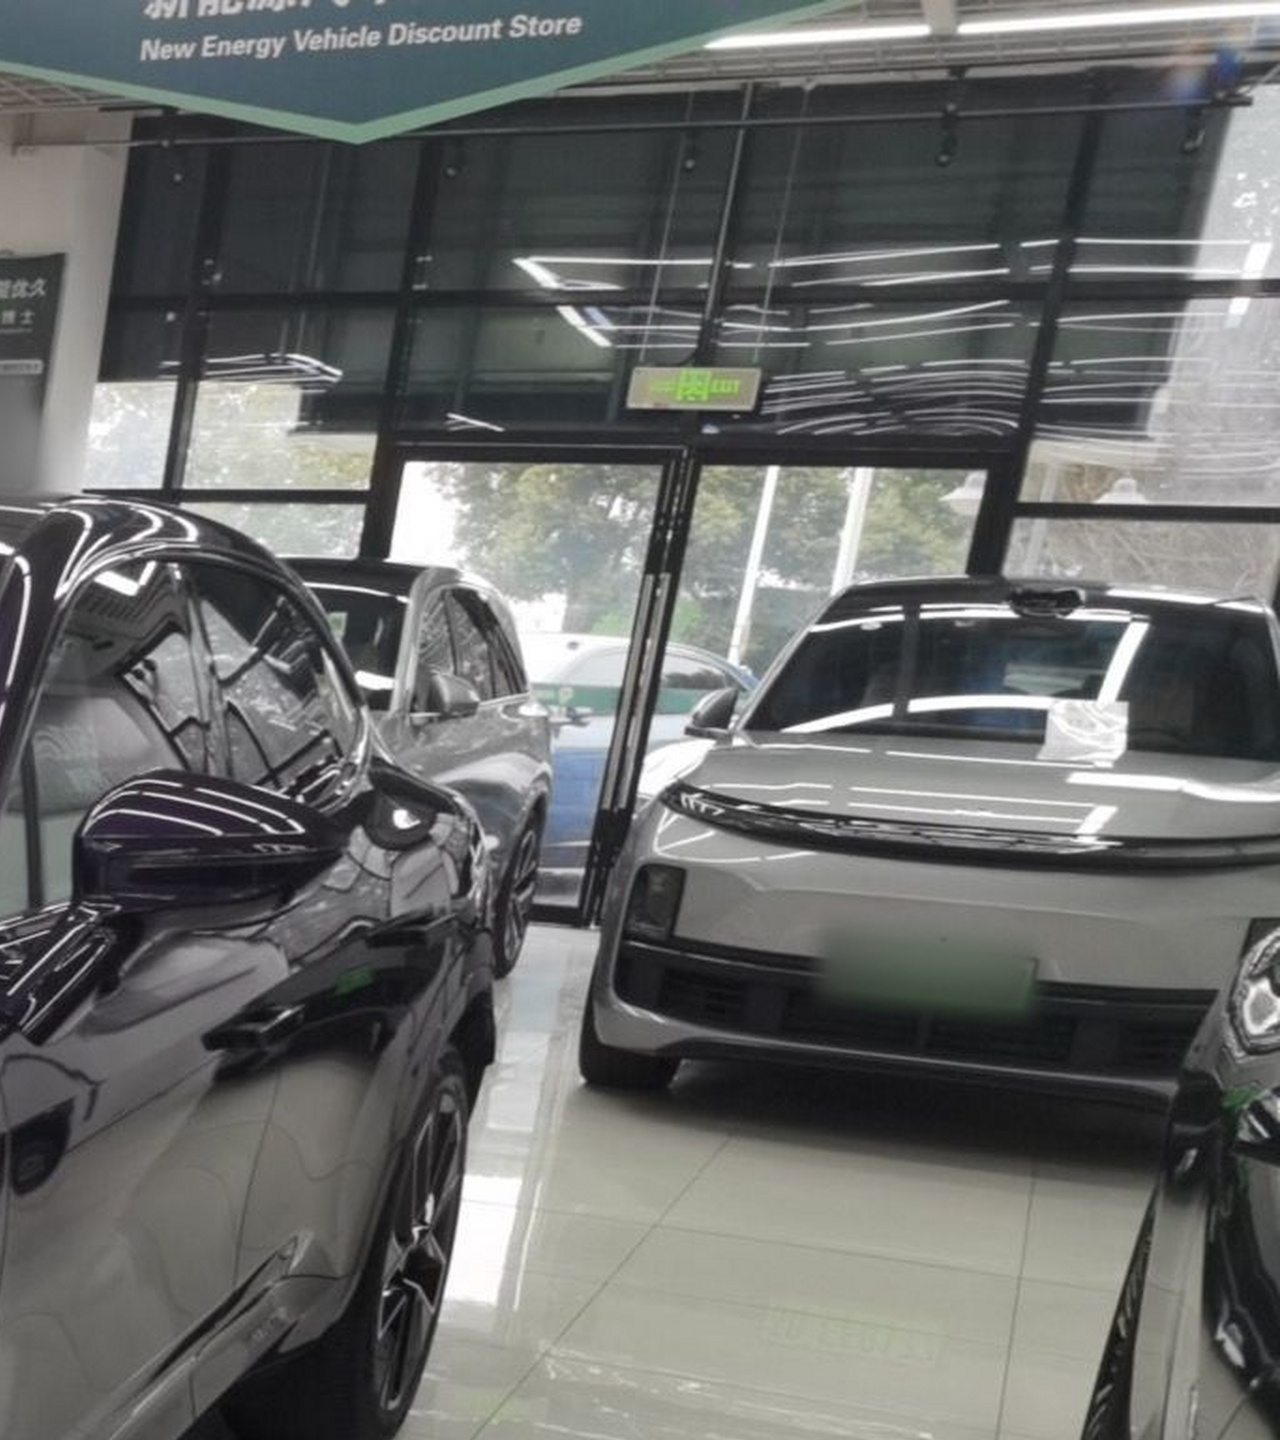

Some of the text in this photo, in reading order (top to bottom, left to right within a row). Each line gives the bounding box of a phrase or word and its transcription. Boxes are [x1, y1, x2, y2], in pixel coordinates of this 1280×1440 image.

[140, 15, 583, 61] New Energy Vehicle Discount Store
